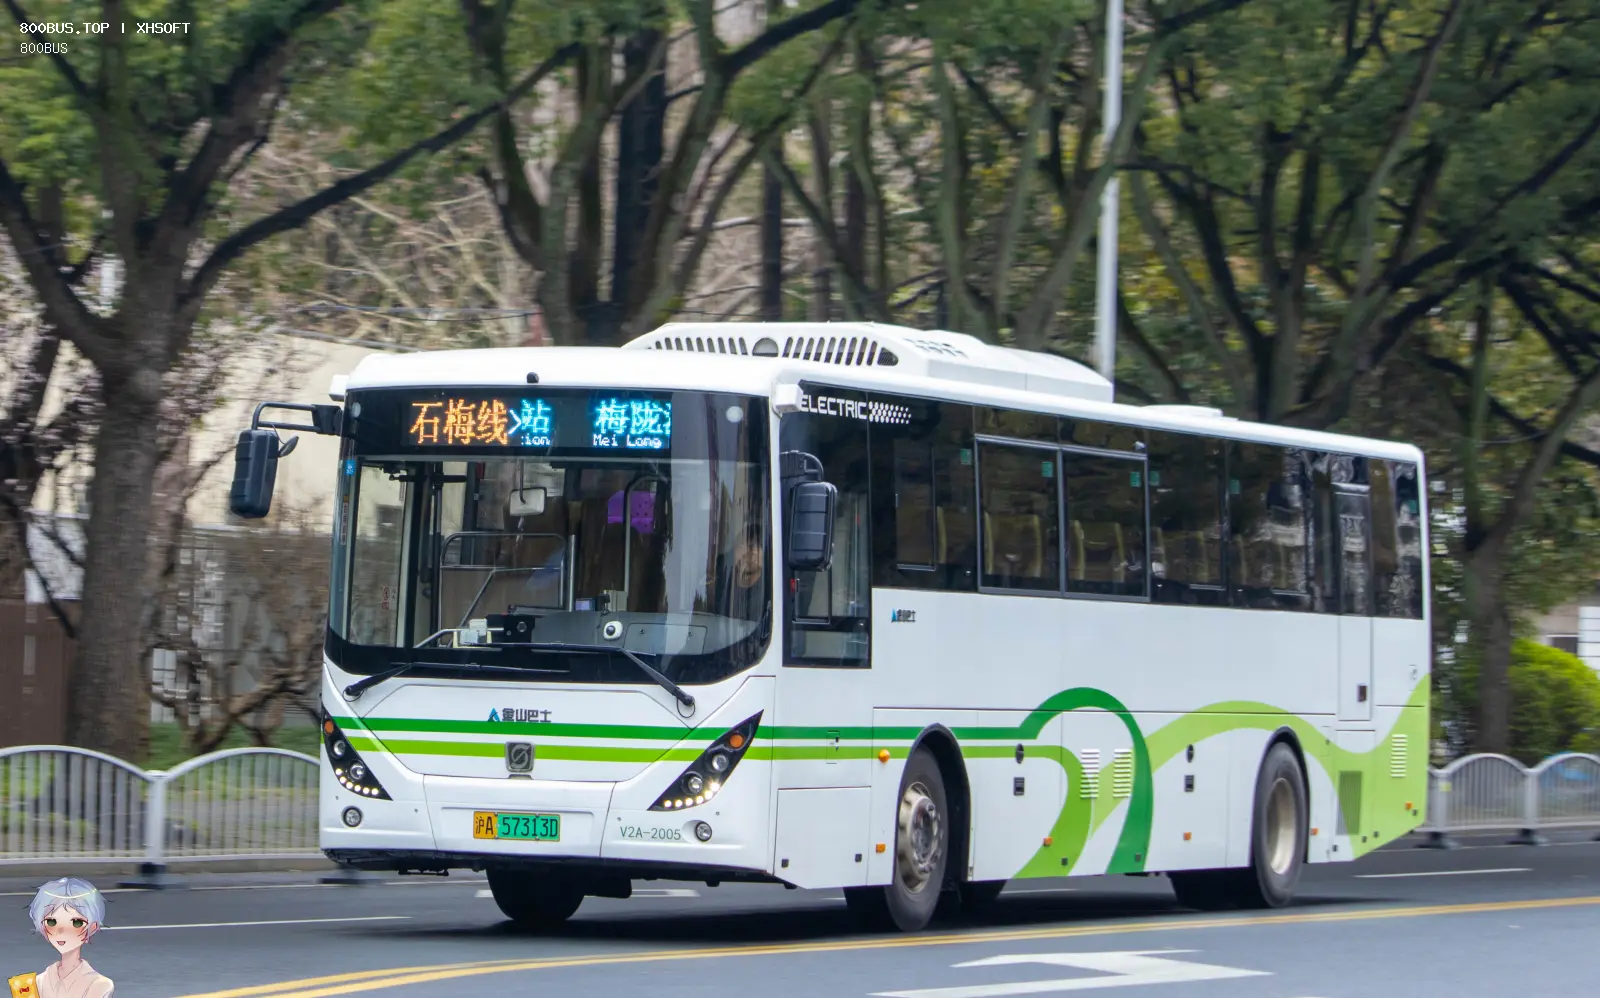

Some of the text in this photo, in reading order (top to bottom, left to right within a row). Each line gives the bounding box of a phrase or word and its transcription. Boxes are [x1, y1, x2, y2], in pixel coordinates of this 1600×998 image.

[521, 398, 671, 434] 站 梅陇
[800, 394, 867, 420] ELECTRIC
[409, 399, 508, 445] 石梅线
[521, 433, 662, 448] ion Mei Long
[501, 707, 552, 723] 金山巴士
[501, 816, 559, 837] 57313D
[619, 826, 681, 841] V2A-2005
